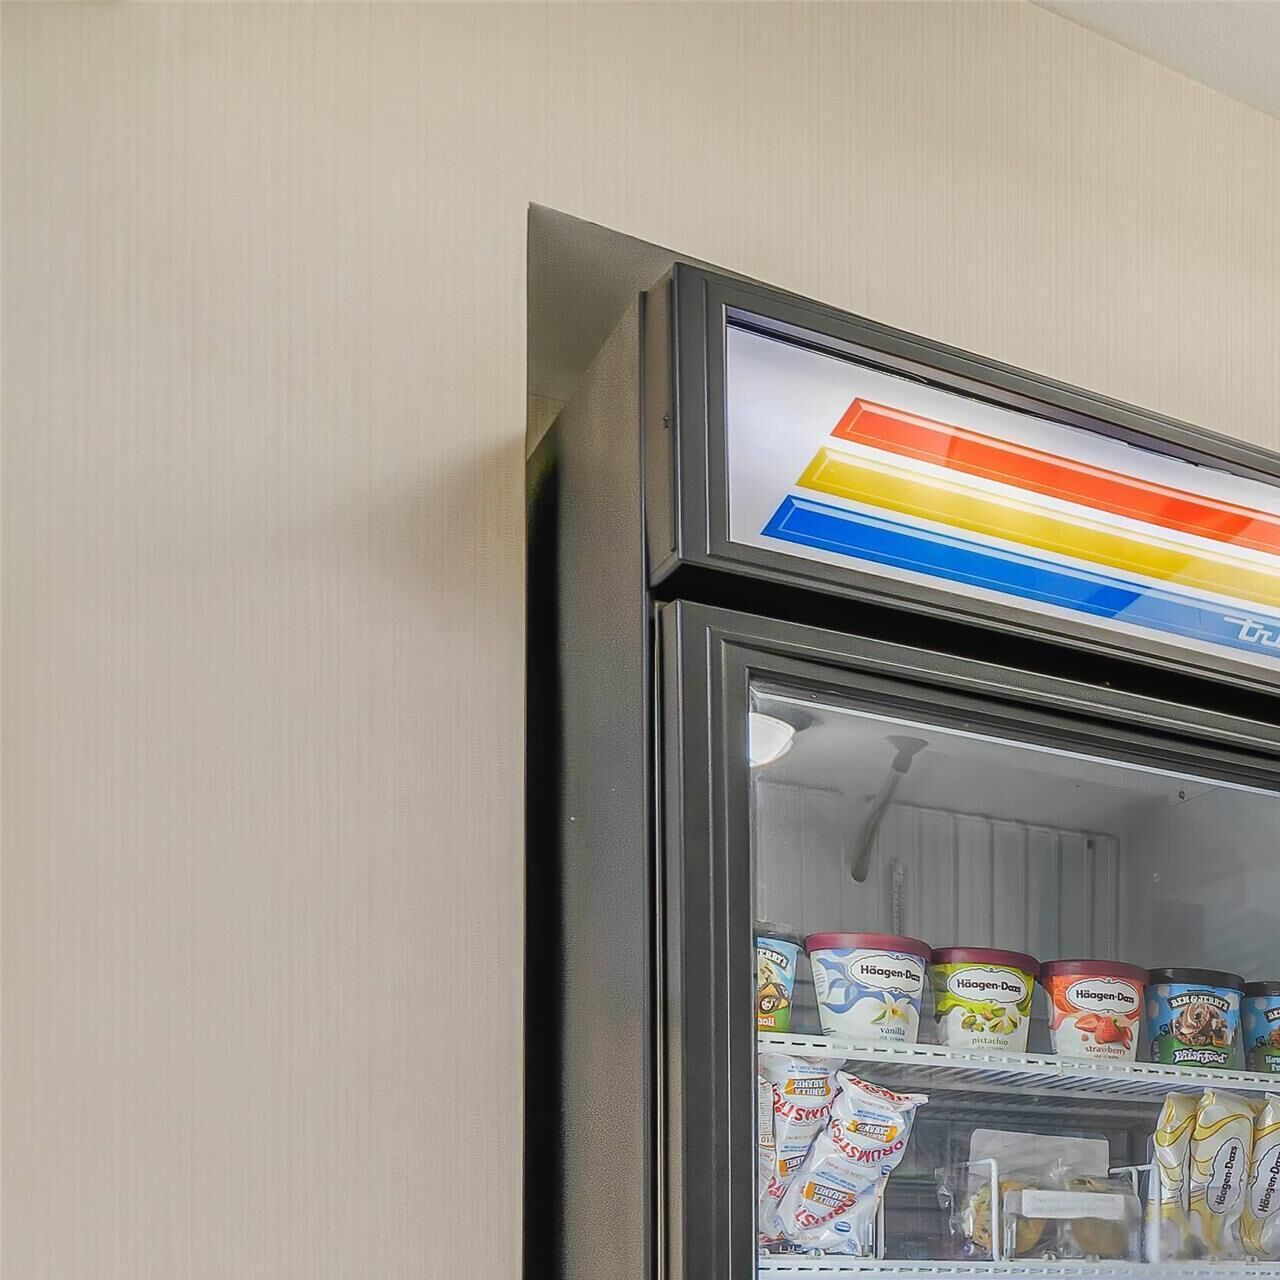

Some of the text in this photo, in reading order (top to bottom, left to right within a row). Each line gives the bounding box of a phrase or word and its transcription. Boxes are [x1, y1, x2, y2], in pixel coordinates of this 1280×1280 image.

[880, 1026, 906, 1037] vanilla
[972, 1036, 1009, 1047] pistachio
[1085, 1044, 1127, 1056] strawberry
